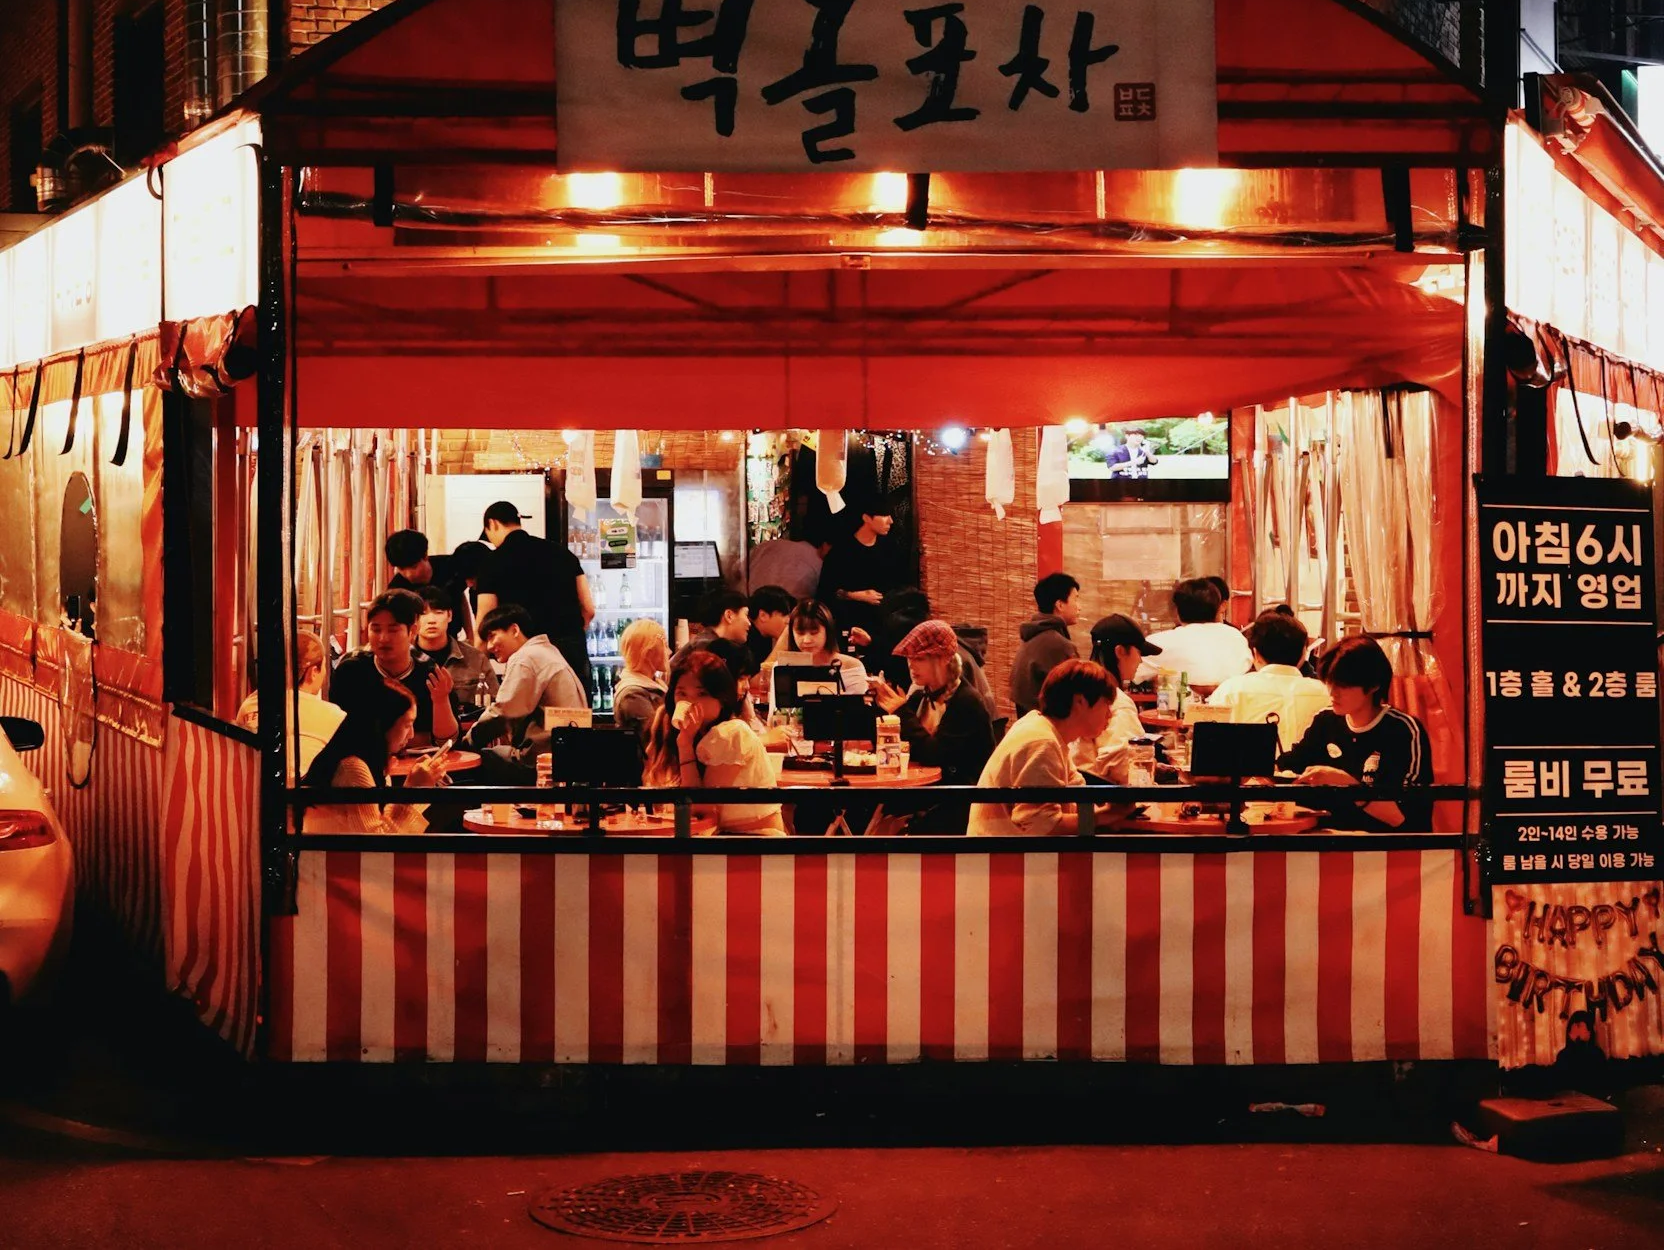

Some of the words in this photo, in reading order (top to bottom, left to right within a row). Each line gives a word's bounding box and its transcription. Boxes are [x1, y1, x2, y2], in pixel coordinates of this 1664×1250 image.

[1492, 520, 1642, 566] 아침6시
[1496, 572, 1562, 609] 까지
[1576, 573, 1642, 610] 영업
[1486, 669, 1523, 698] 1층
[1530, 669, 1555, 698] 홀
[1562, 670, 1582, 698] &
[1588, 670, 1627, 698] 2층
[1635, 671, 1657, 698] 룸
[1503, 760, 1570, 799] 룸비
[1582, 760, 1649, 799] 무료
[1517, 825, 1578, 842] 2인~14인
[1581, 824, 1608, 841] 수용
[1612, 824, 1639, 840] 가능
[1503, 854, 1516, 871] 룸
[1551, 854, 1564, 870] 시
[1567, 853, 1594, 870] 당일
[1599, 852, 1626, 869] 이용
[1630, 851, 1655, 868] 가능
[1523, 897, 1640, 948] HAPPY
[1494, 932, 1664, 1022] BIRTHDAY
